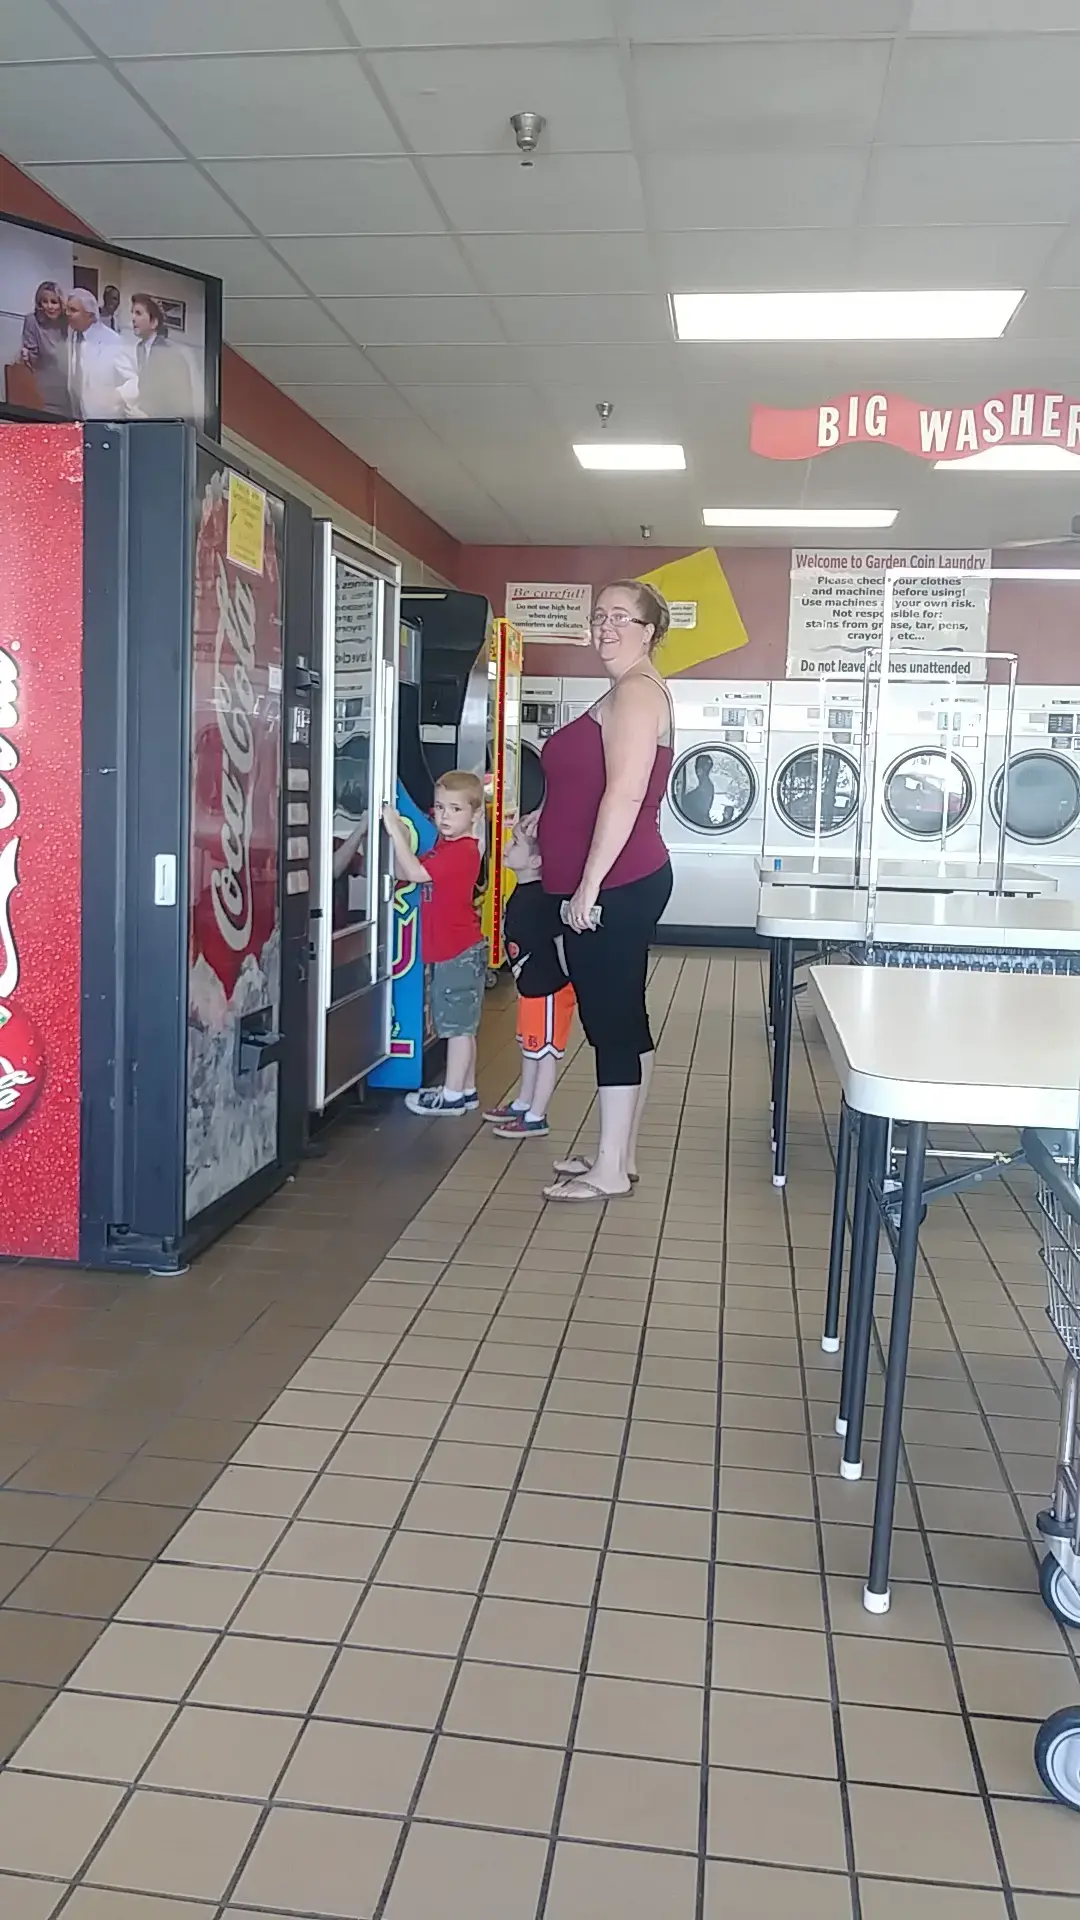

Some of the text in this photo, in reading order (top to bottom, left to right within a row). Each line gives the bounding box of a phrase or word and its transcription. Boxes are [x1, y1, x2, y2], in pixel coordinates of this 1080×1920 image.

[815, 394, 888, 448] BIG
[796, 554, 986, 570] Welcome to Garden Coin Laundry
[817, 576, 854, 585] Please
[920, 577, 961, 586] clothes
[513, 588, 585, 600] Be careful!
[811, 587, 832, 596] and
[892, 587, 928, 596] before
[931, 588, 966, 598] using!
[801, 598, 822, 607] Use
[824, 598, 878, 607] machines
[895, 600, 921, 609] your
[923, 600, 948, 608] own
[951, 599, 976, 608] risk.
[547, 613, 568, 621] drying
[832, 609, 852, 618] Not
[922, 610, 943, 619] for:
[805, 620, 969, 632] stains from grase, tar, pens,
[801, 660, 815, 672] Do
[817, 661, 836, 673] not
[838, 660, 865, 673] leave
[909, 662, 971, 674] unattended
